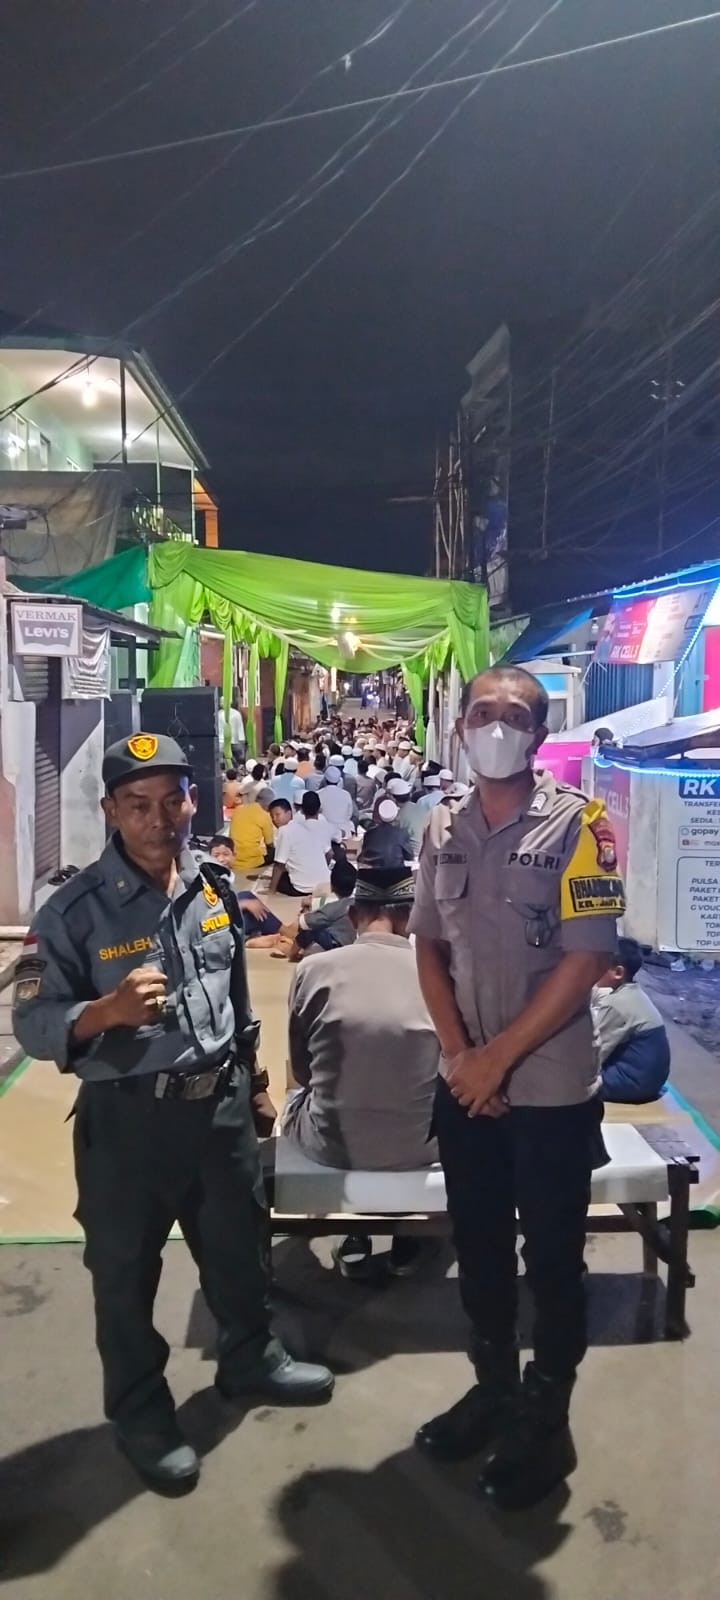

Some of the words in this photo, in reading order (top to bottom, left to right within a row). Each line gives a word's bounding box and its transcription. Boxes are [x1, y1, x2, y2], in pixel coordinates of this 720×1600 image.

[16, 610, 77, 621] VERMAK
[683, 779, 717, 795] RK
[508, 852, 560, 870] POLRI
[99, 936, 154, 960] SHALEH
